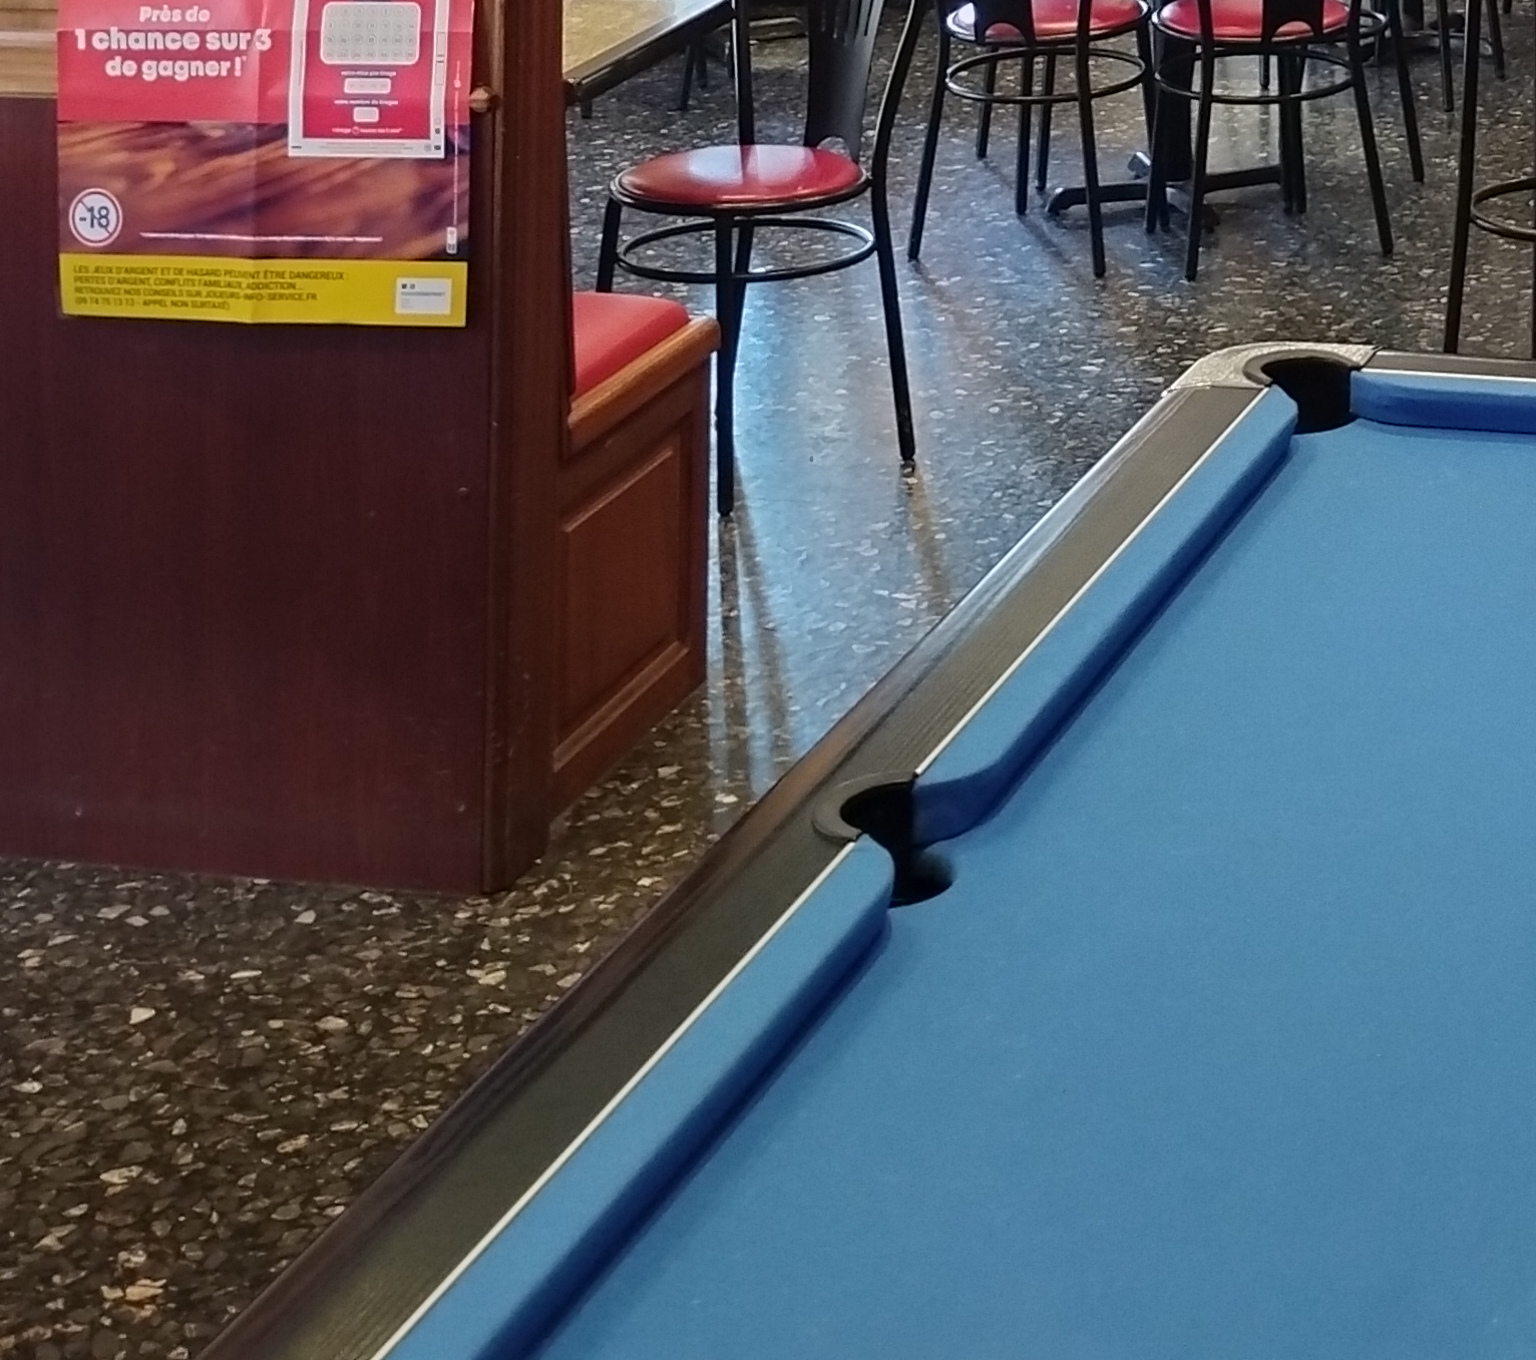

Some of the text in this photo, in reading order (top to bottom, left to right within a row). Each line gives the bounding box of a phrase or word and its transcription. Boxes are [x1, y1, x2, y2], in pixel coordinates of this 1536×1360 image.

[140, 4, 210, 22] Près de
[75, 26, 272, 51] 1 chance sur 3
[105, 56, 138, 77] de
[142, 59, 231, 82] gagner
[79, 206, 110, 228] -18
[74, 265, 344, 280] LES JEUX D'ARGENT ET DE HASARD PEUVENT ÊTRE DANGEREUX
[74, 276, 106, 284] PERTES
[154, 278, 196, 287] CONFLITS
[74, 286, 122, 296] RETROUVEZ
[124, 288, 141, 296] NOS
[142, 288, 184, 297] CONSEILS
[186, 288, 202, 298] SUR
[142, 299, 168, 308] APPEL
[170, 300, 189, 308] NON
